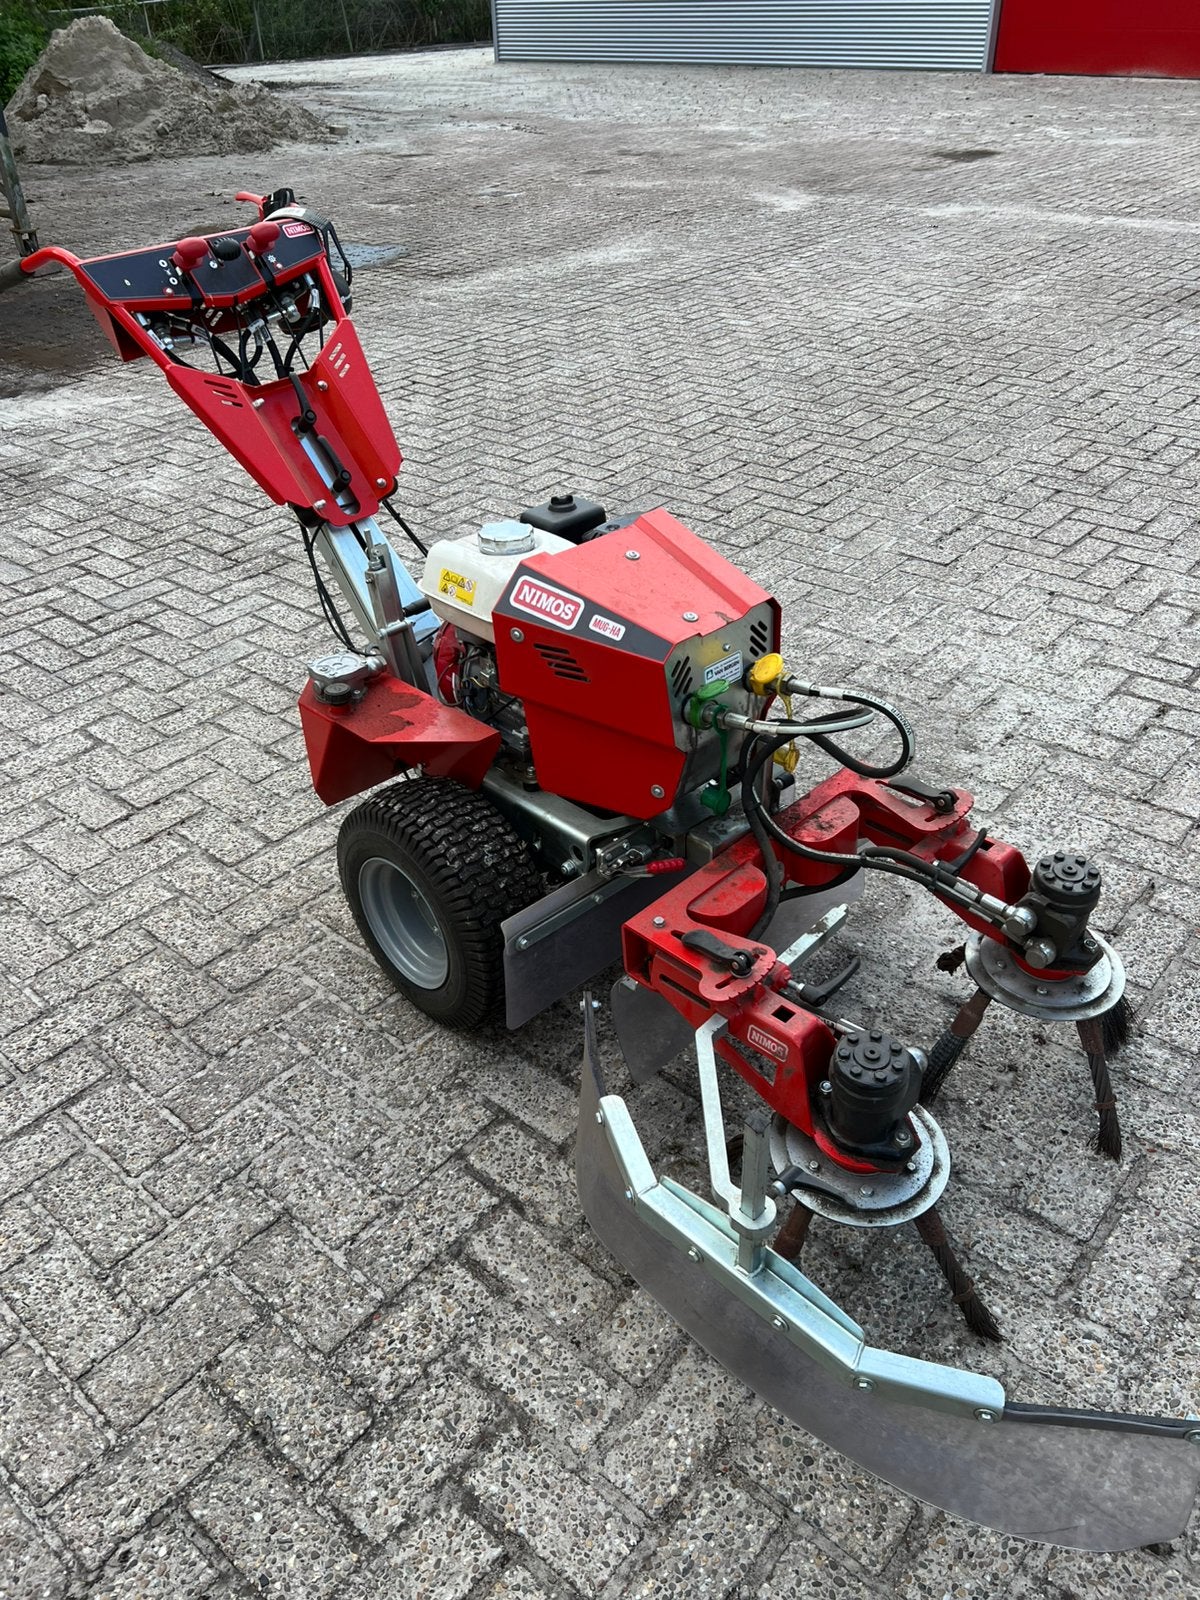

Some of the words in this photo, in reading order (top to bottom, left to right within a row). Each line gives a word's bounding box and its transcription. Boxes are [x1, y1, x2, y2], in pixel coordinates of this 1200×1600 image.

[285, 224, 312, 236] NIMOS
[518, 584, 576, 621] NIMOS
[591, 617, 623, 638] MUG-HA
[750, 1030, 784, 1057] NIMOS
